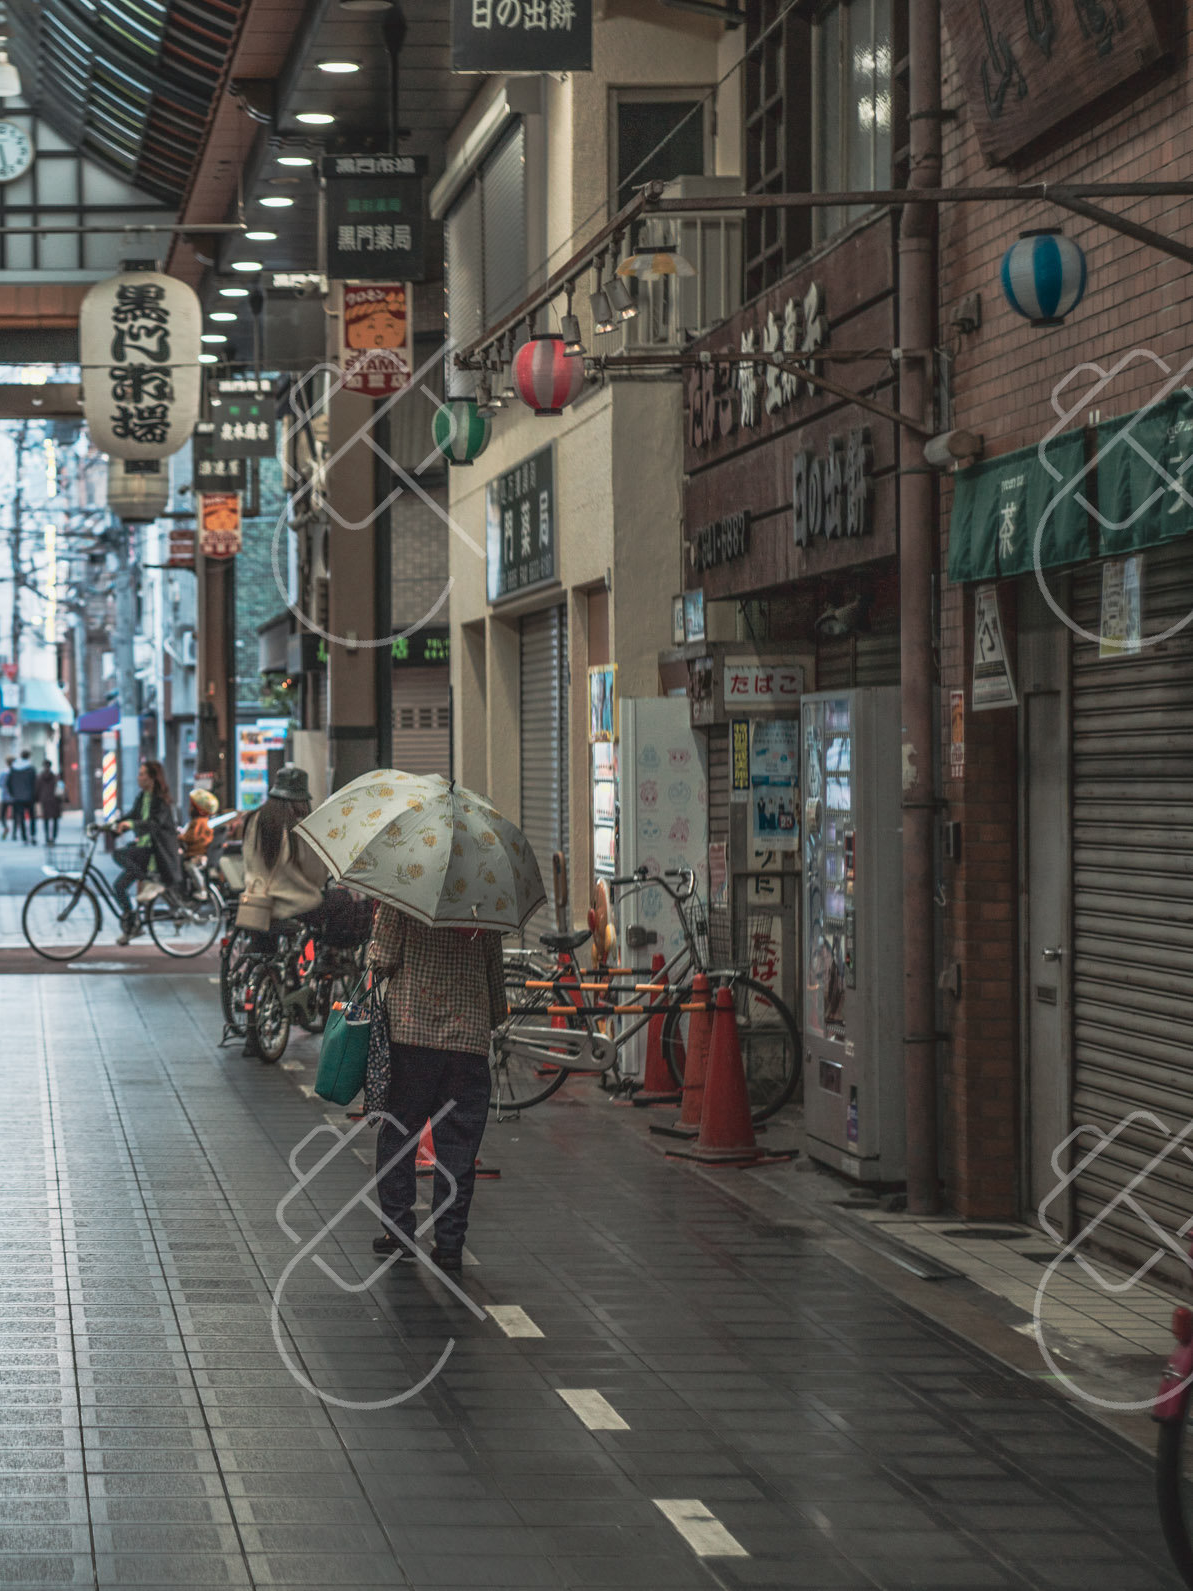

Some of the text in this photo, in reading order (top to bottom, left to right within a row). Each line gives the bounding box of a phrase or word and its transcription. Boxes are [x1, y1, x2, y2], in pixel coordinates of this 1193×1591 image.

[471, 0, 577, 31] 日の出餅
[338, 224, 412, 251] 黒門薬局
[730, 674, 798, 696] たばこ
